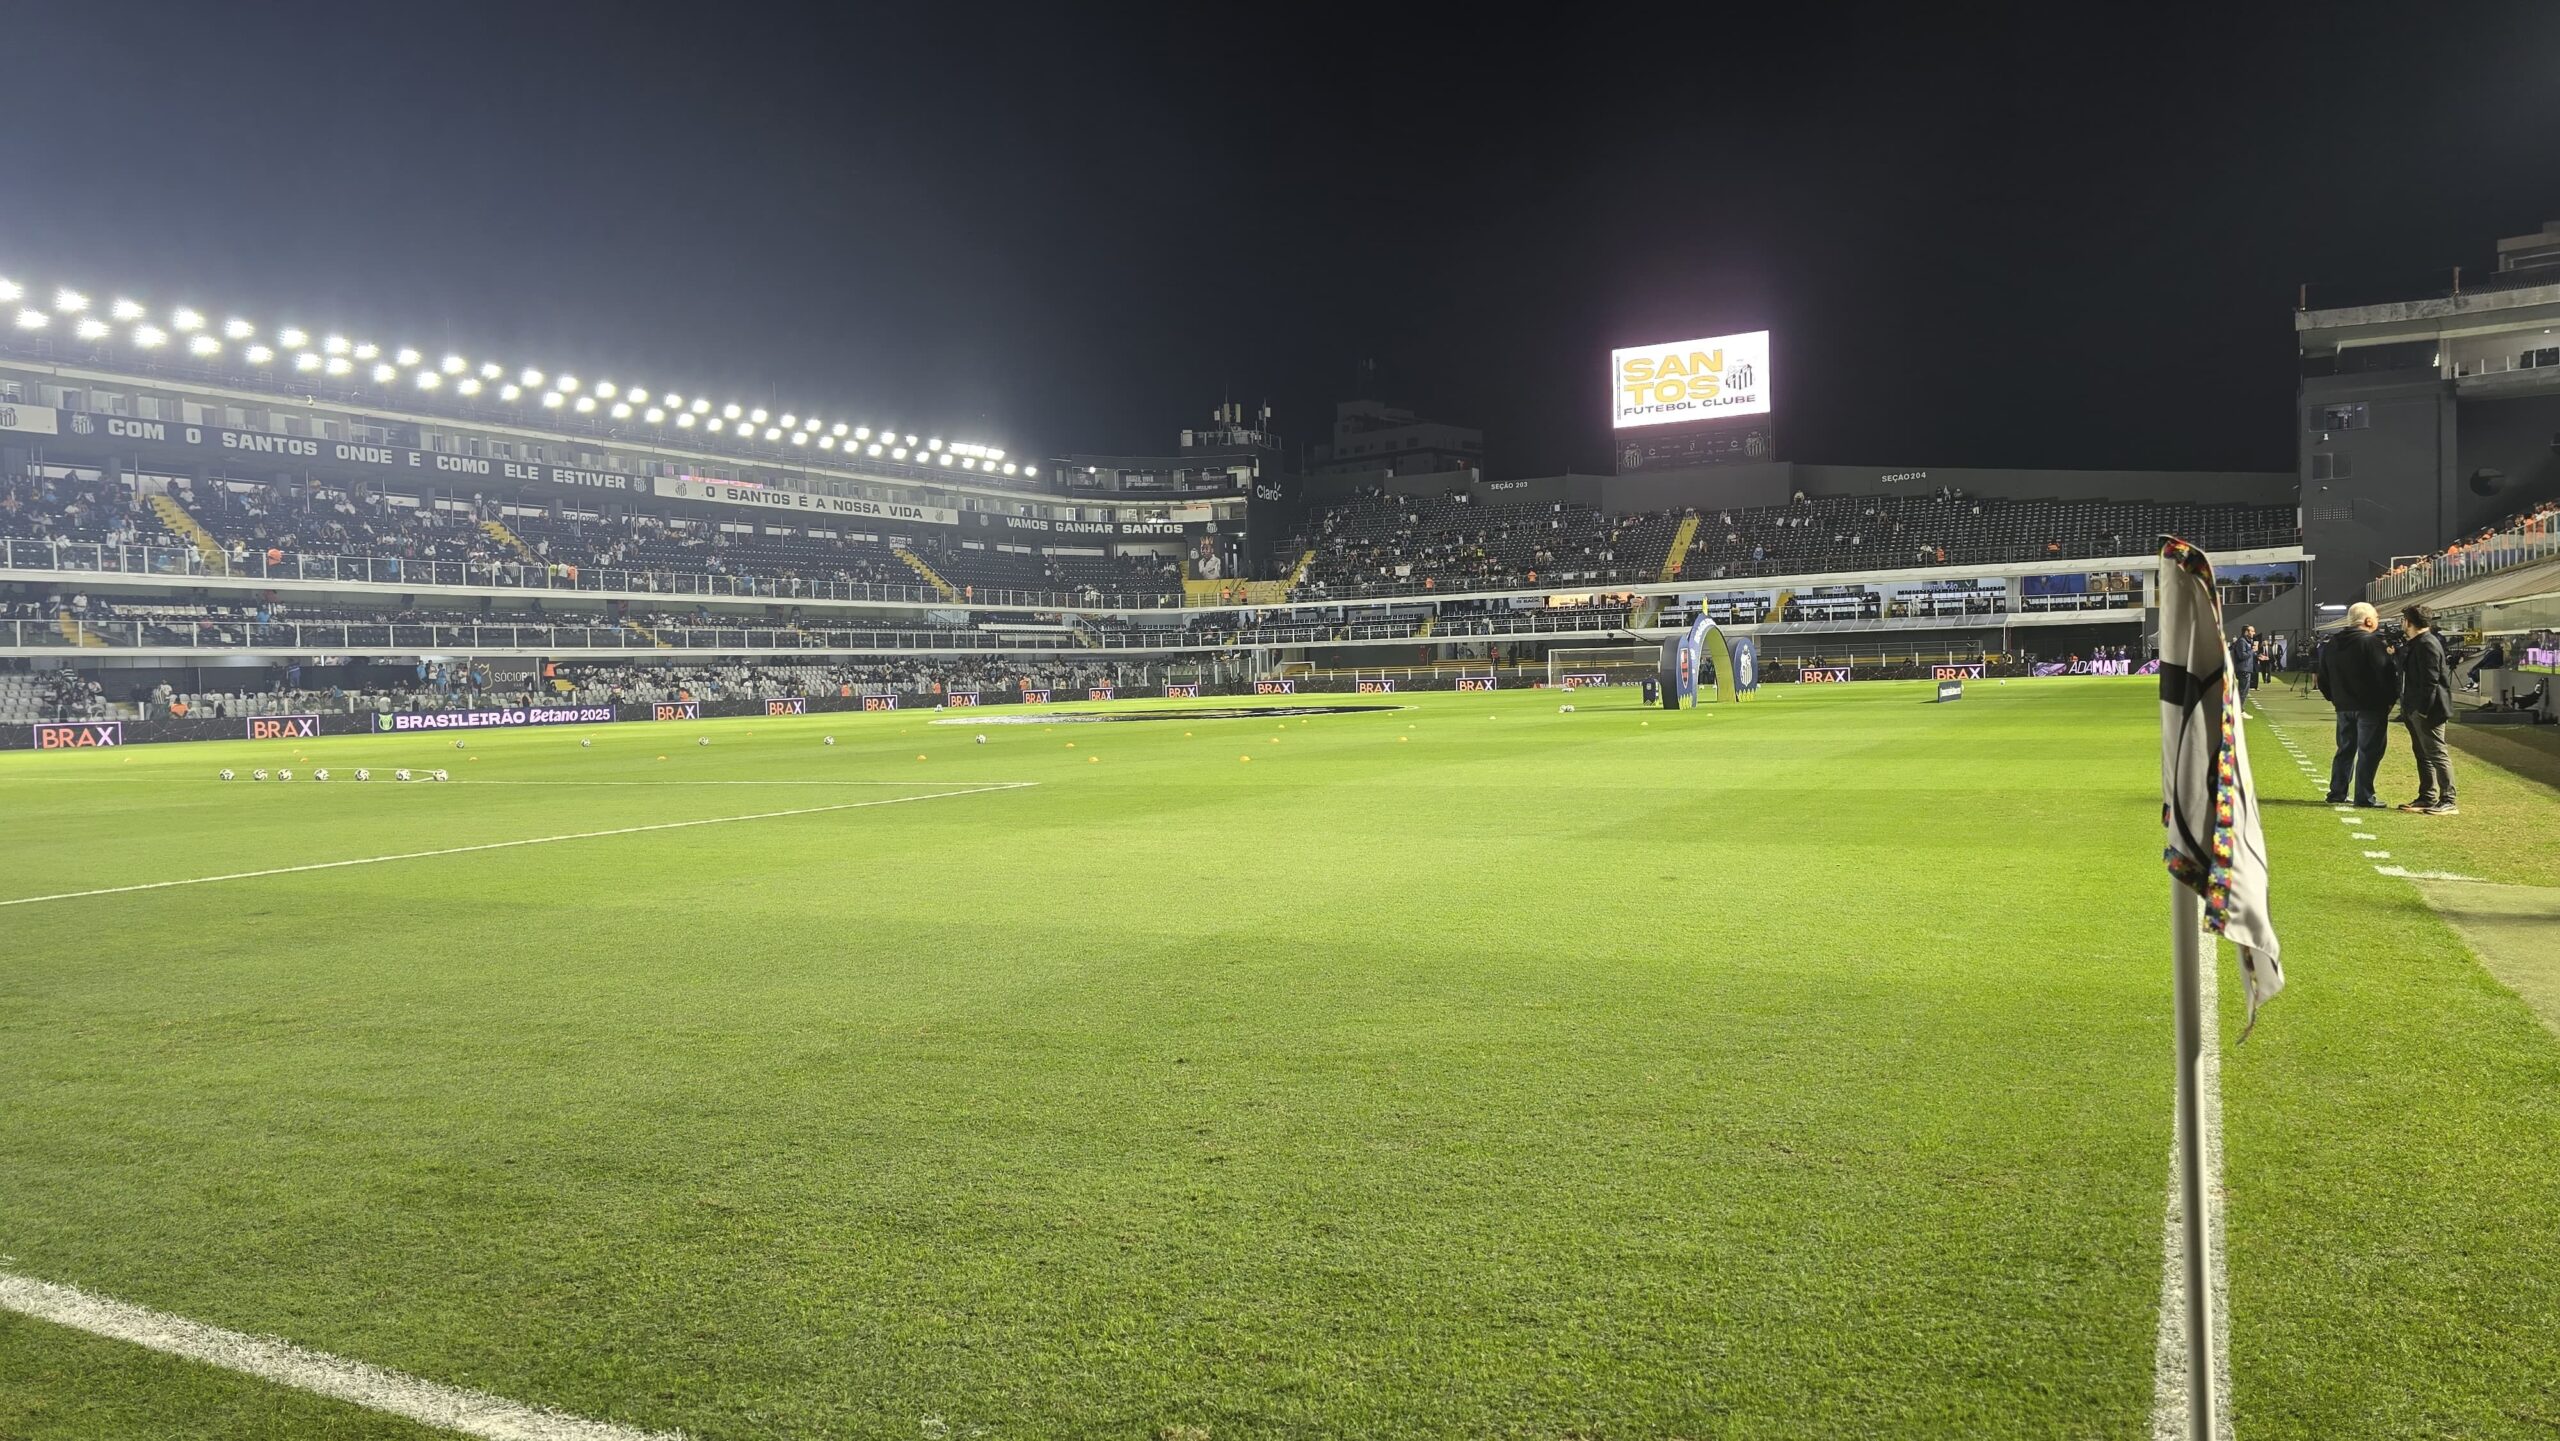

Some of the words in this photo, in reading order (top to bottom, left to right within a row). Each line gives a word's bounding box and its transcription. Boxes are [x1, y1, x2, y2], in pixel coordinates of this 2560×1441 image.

[1623, 348, 1723, 383] SAN
[1623, 375, 1720, 406] TOS
[1623, 401, 1697, 416] FUTEBOL
[1702, 394, 1756, 407] CLUBE
[108, 418, 165, 441] COM
[185, 428, 202, 444] O
[222, 431, 318, 456] SANTOS
[335, 444, 392, 464] ONDE
[408, 451, 421, 467] E
[436, 455, 490, 475] COMO
[504, 463, 539, 481] ELE
[552, 468, 626, 490] ESTIVER
[1257, 483, 1280, 501] Claro
[1515, 481, 1528, 489] 203
[705, 485, 716, 498] O
[726, 487, 791, 506] SANTOS
[815, 497, 826, 510] A
[833, 499, 881, 515] NOSSA
[888, 505, 923, 519] VIDA
[1006, 516, 1048, 531] VAMOS
[1055, 522, 1113, 535] GANHAR
[1122, 523, 1184, 535] SANTOS
[1804, 670, 1846, 683] BRAX
[1936, 667, 1981, 680] BRAX
[1168, 687, 1196, 698] BRAX
[1257, 683, 1291, 694] BRAX
[1359, 682, 1391, 693] BRAX
[1459, 679, 1493, 691] BRAX
[950, 694, 979, 707] BRAX
[1025, 691, 1048, 704] BRAX
[1091, 690, 1112, 701] BRAX
[769, 701, 802, 716] BRAX
[865, 697, 894, 711] BRAX
[396, 708, 526, 729] BRASILEIRÃO
[529, 707, 578, 724] Betano
[580, 708, 611, 722] 2025
[657, 705, 696, 721] BRAX
[253, 719, 314, 740] BRAX
[42, 726, 115, 749] BRAX
